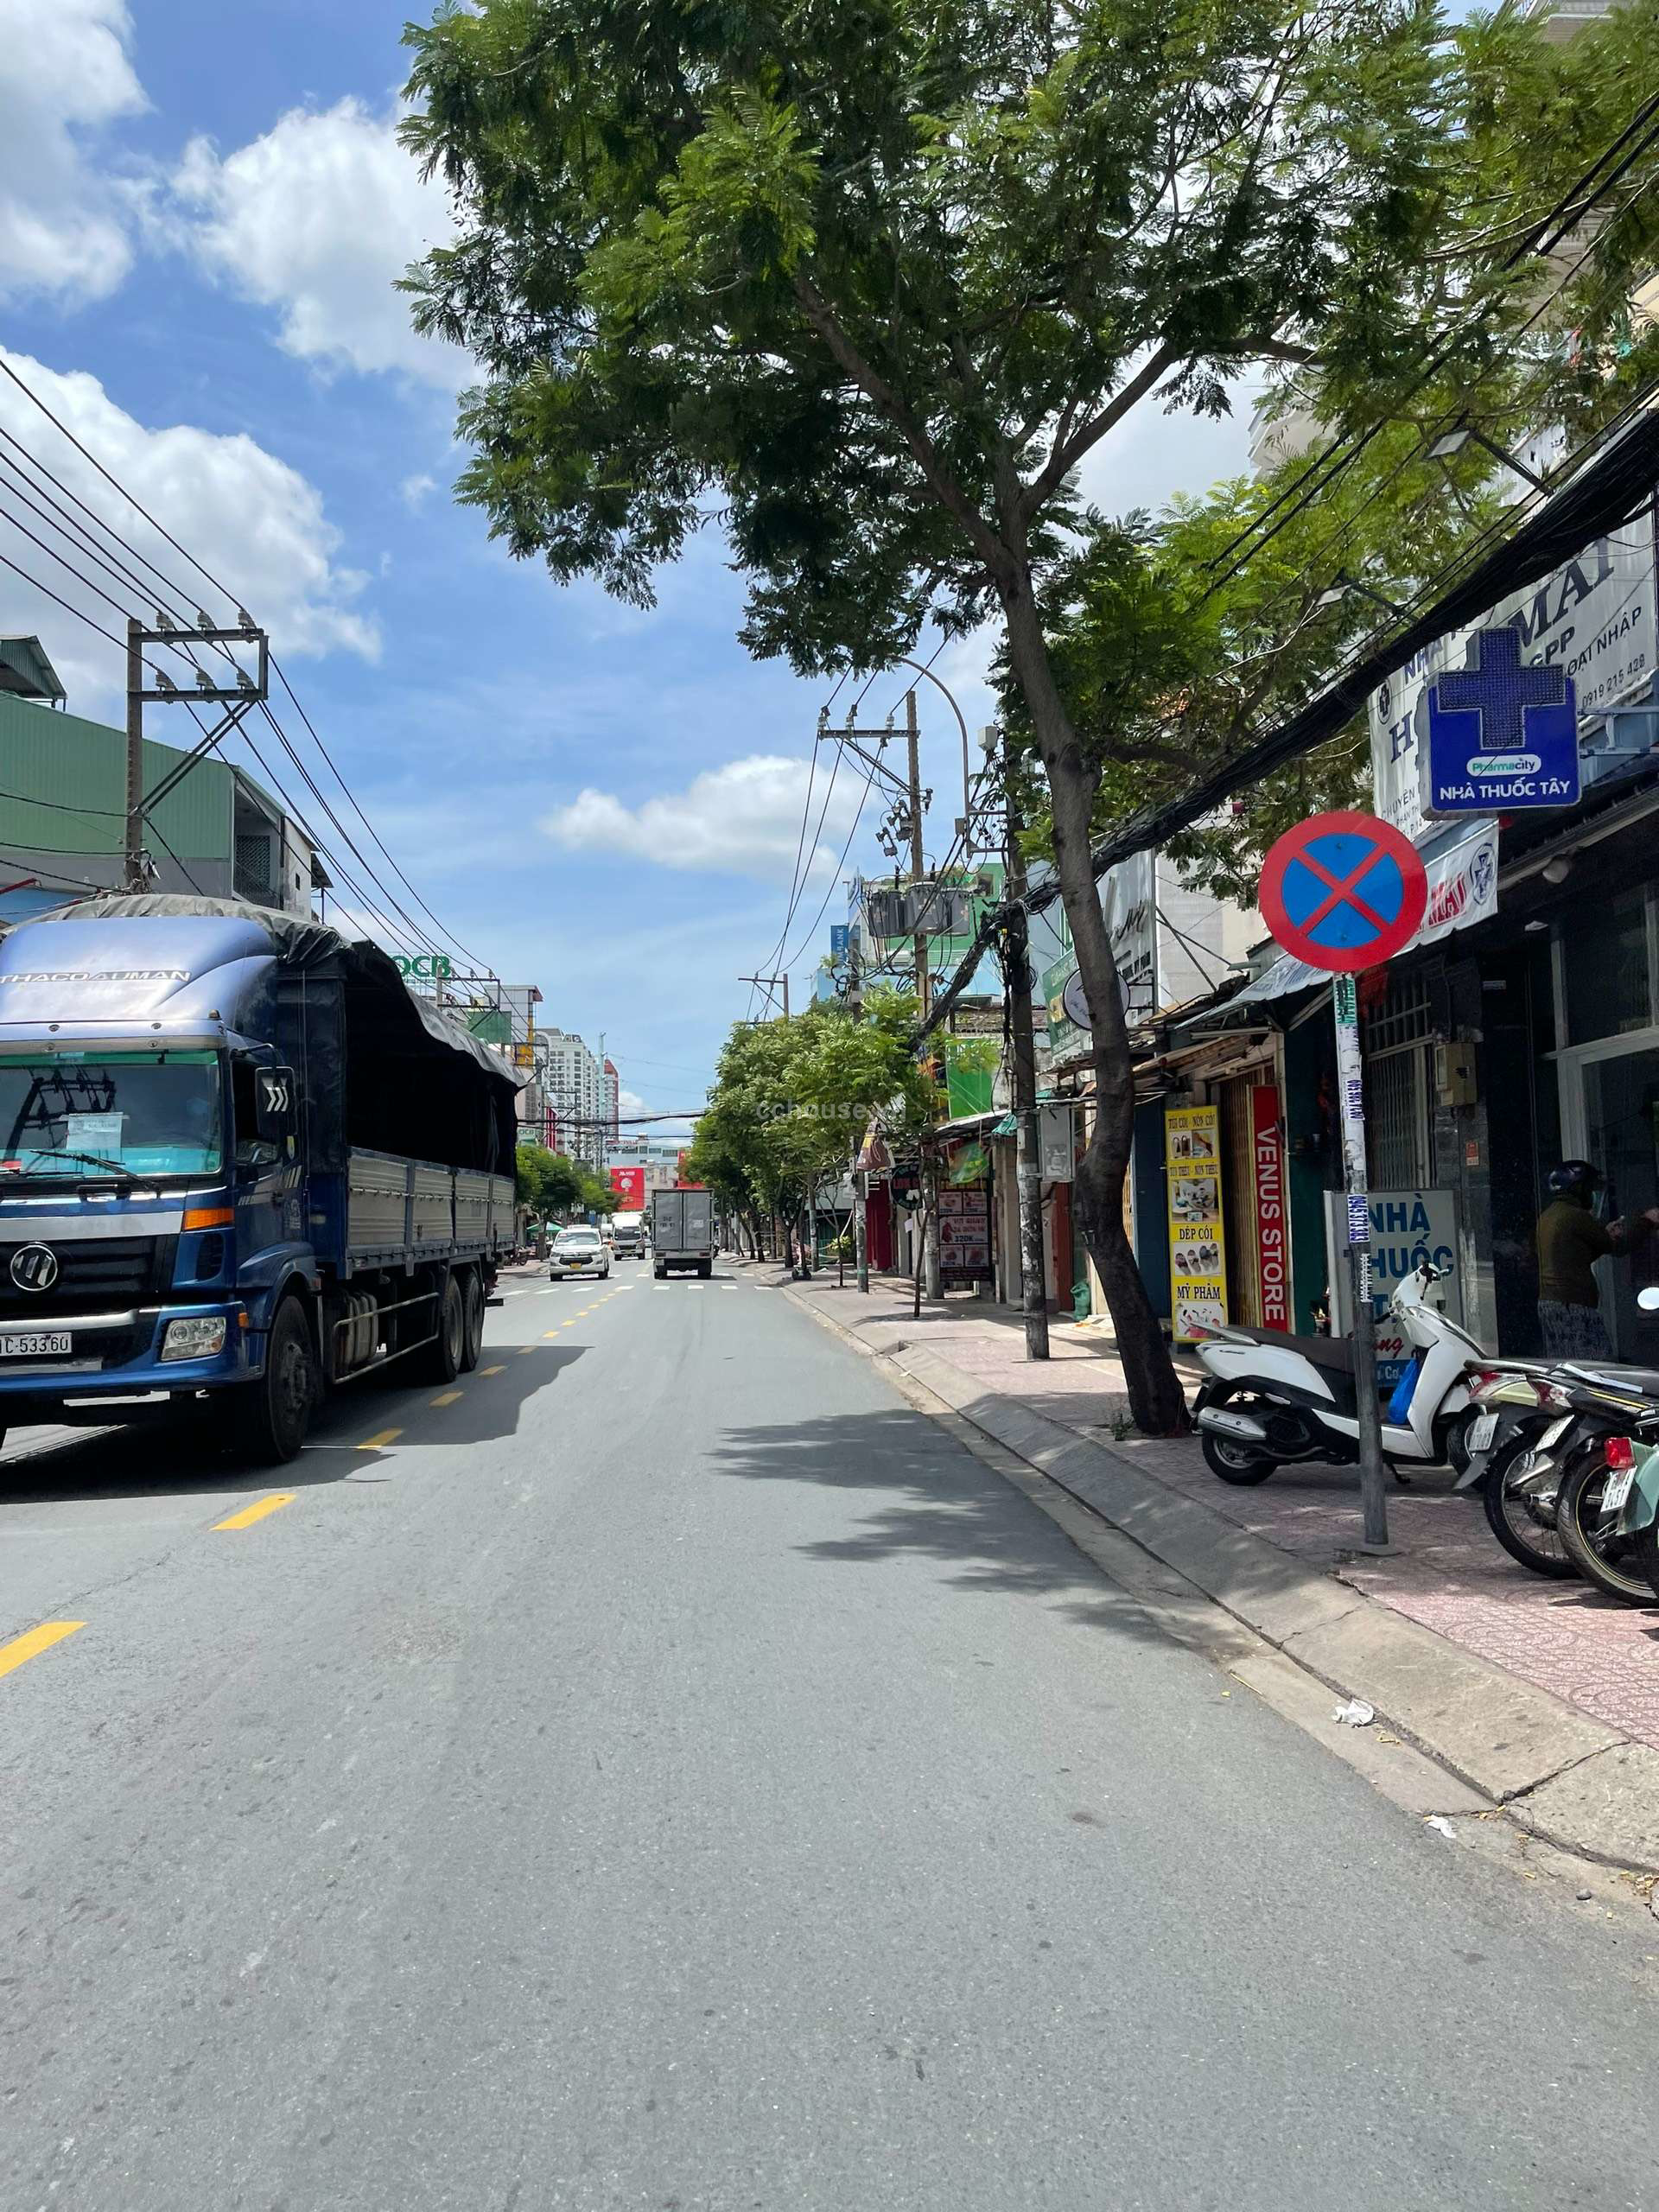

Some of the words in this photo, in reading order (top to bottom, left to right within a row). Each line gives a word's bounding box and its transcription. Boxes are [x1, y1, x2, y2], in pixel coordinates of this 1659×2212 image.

[1597, 606, 1643, 655] NHẬP
[1471, 757, 1535, 772] Pharmacity
[1440, 782, 1476, 800] NHÀ
[1479, 777, 1536, 798] THUỐC
[1540, 778, 1571, 796] TÂY
[391, 955, 451, 977] OCB
[1257, 1126, 1281, 1220] VENUS
[1262, 1228, 1285, 1321] STORE
